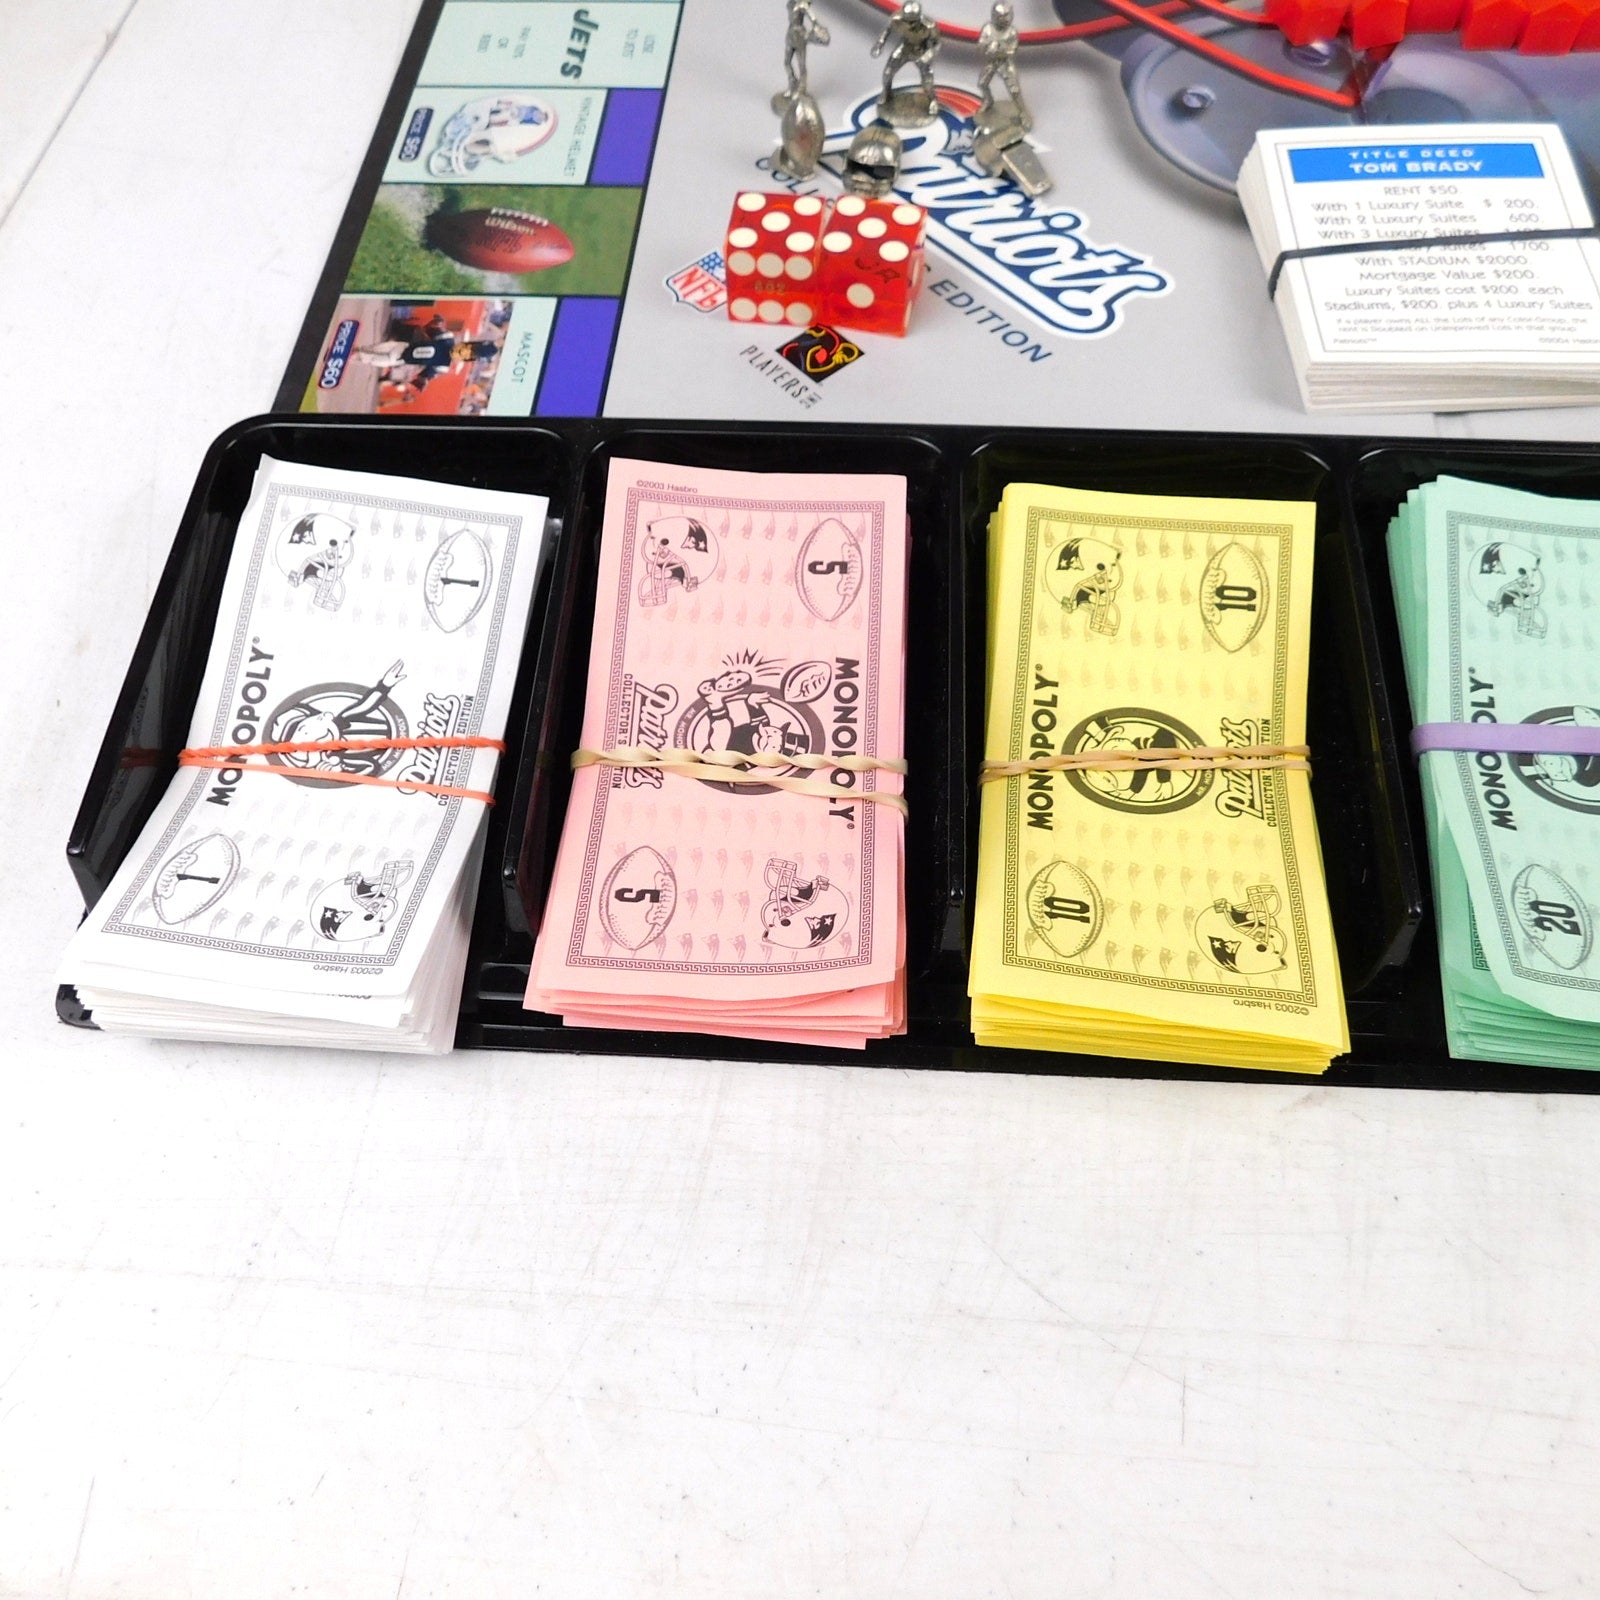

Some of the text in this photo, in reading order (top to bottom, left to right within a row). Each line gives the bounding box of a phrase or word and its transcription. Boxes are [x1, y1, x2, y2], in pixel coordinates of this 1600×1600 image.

[560, 8, 600, 80] JETS
[1348, 147, 1475, 160] TITLE DEED
[1348, 159, 1484, 174] TOM BRADY
[1384, 185, 1421, 196] RENT
[1311, 202, 1348, 212] With
[1356, 202, 1362, 211] 1
[1368, 200, 1420, 213] Luxury
[1425, 199, 1465, 210] Suite
[1482, 198, 1492, 208] $
[1314, 215, 1351, 226] With
[1358, 215, 1367, 225] 2
[1372, 213, 1424, 227] Luxury
[1429, 213, 1477, 224] Suites
[1317, 229, 1355, 240] With
[1362, 229, 1370, 239] 3
[1376, 227, 1428, 241] Luxury
[1355, 256, 1393, 267] With
[1398, 255, 1471, 267] STADIUM
[1359, 271, 1437, 282] Mortgage
[1441, 269, 1487, 281] Value
[1344, 285, 1393, 297] Luxury
[1396, 285, 1441, 296] Suites
[1444, 285, 1477, 295] cost
[1527, 285, 1564, 295] each
[1324, 300, 1396, 312] Stadiums,
[1447, 299, 1479, 311] plus
[1497, 298, 1545, 311] Luxury
[1548, 299, 1593, 310] Suites
[928, 279, 1053, 363] EDITION
[320, 319, 354, 389] PRICE $60
[511, 330, 535, 384] MASCOT
[739, 344, 809, 399] PLAYERS
[636, 479, 699, 494] ©2003 Hasbro
[807, 559, 848, 577] 5
[1214, 584, 1258, 612] 10
[456, 694, 475, 735] EDITION
[617, 673, 634, 746] COLLECTOR'S
[614, 886, 661, 904] 5
[1043, 896, 1091, 925] 10
[1528, 899, 1583, 937] 20
[312, 963, 384, 976] ©2003 Hasbro
[1232, 999, 1310, 1016] ©2003 Hasbro
